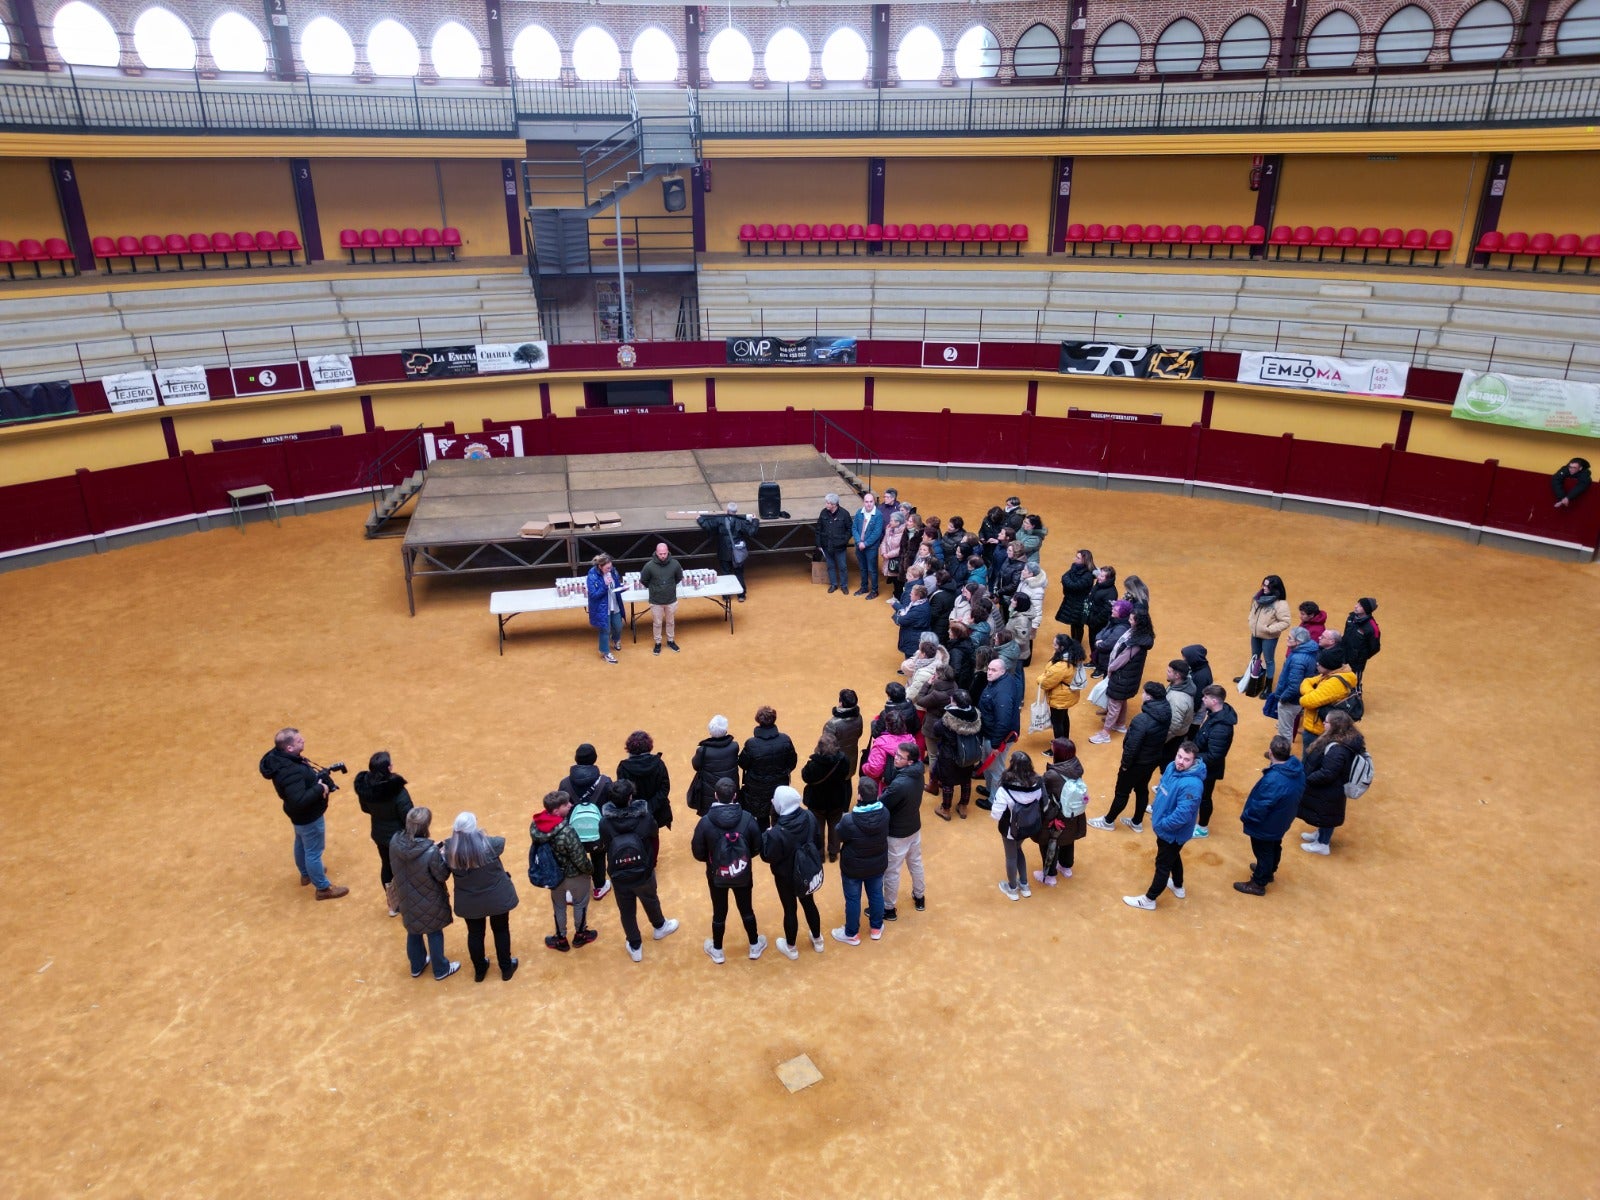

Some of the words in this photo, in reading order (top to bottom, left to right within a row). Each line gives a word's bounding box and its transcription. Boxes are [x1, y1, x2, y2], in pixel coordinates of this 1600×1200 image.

[275, 0, 282, 10] 2
[491, 10, 498, 20] 2
[881, 12, 886, 22] 1
[1078, 7, 1083, 17] 1
[689, 14, 694, 24] 1
[301, 169, 308, 179] 3
[506, 168, 512, 178] 3
[694, 168, 700, 176] 2
[877, 167, 882, 176] 2
[1063, 166, 1069, 176] 2
[1266, 165, 1273, 175] 2
[1498, 164, 1504, 175] 1
[64, 170, 72, 181] 3
[433, 353, 444, 363] LA
[448, 352, 477, 362] ENCINA
[946, 347, 954, 359] 2
[318, 366, 352, 380] TEJEMO
[1267, 363, 1342, 382] EMJOMA
[263, 371, 273, 385] 3
[164, 380, 206, 394] TEJEMO
[112, 386, 154, 401] TEJEMO
[720, 859, 748, 877] FILA
